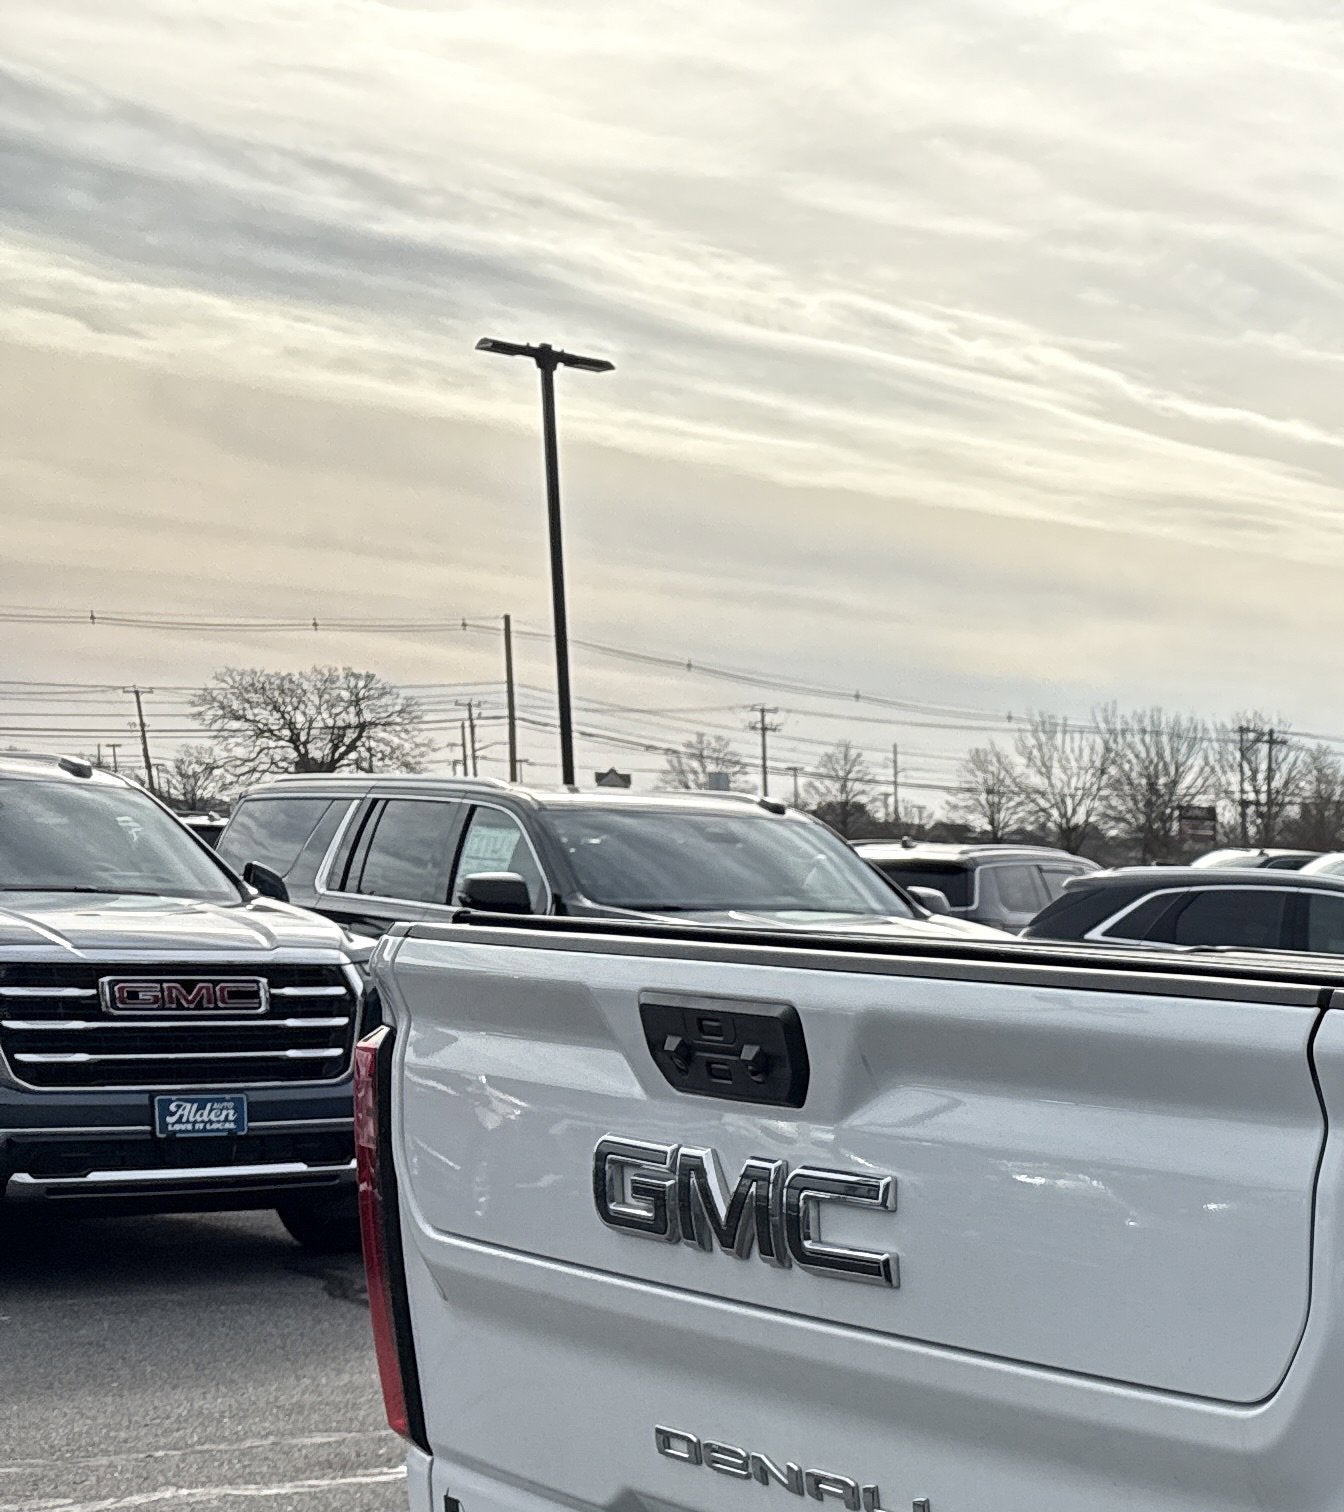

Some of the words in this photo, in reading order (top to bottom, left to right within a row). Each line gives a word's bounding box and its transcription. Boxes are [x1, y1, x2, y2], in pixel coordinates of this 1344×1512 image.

[115, 982, 261, 1009] GMC
[166, 1101, 238, 1123] Alden
[168, 1123, 193, 1131] LOVE
[195, 1122, 205, 1130] IT
[206, 1121, 237, 1130] LOCAL
[593, 1132, 900, 1288] GMC
